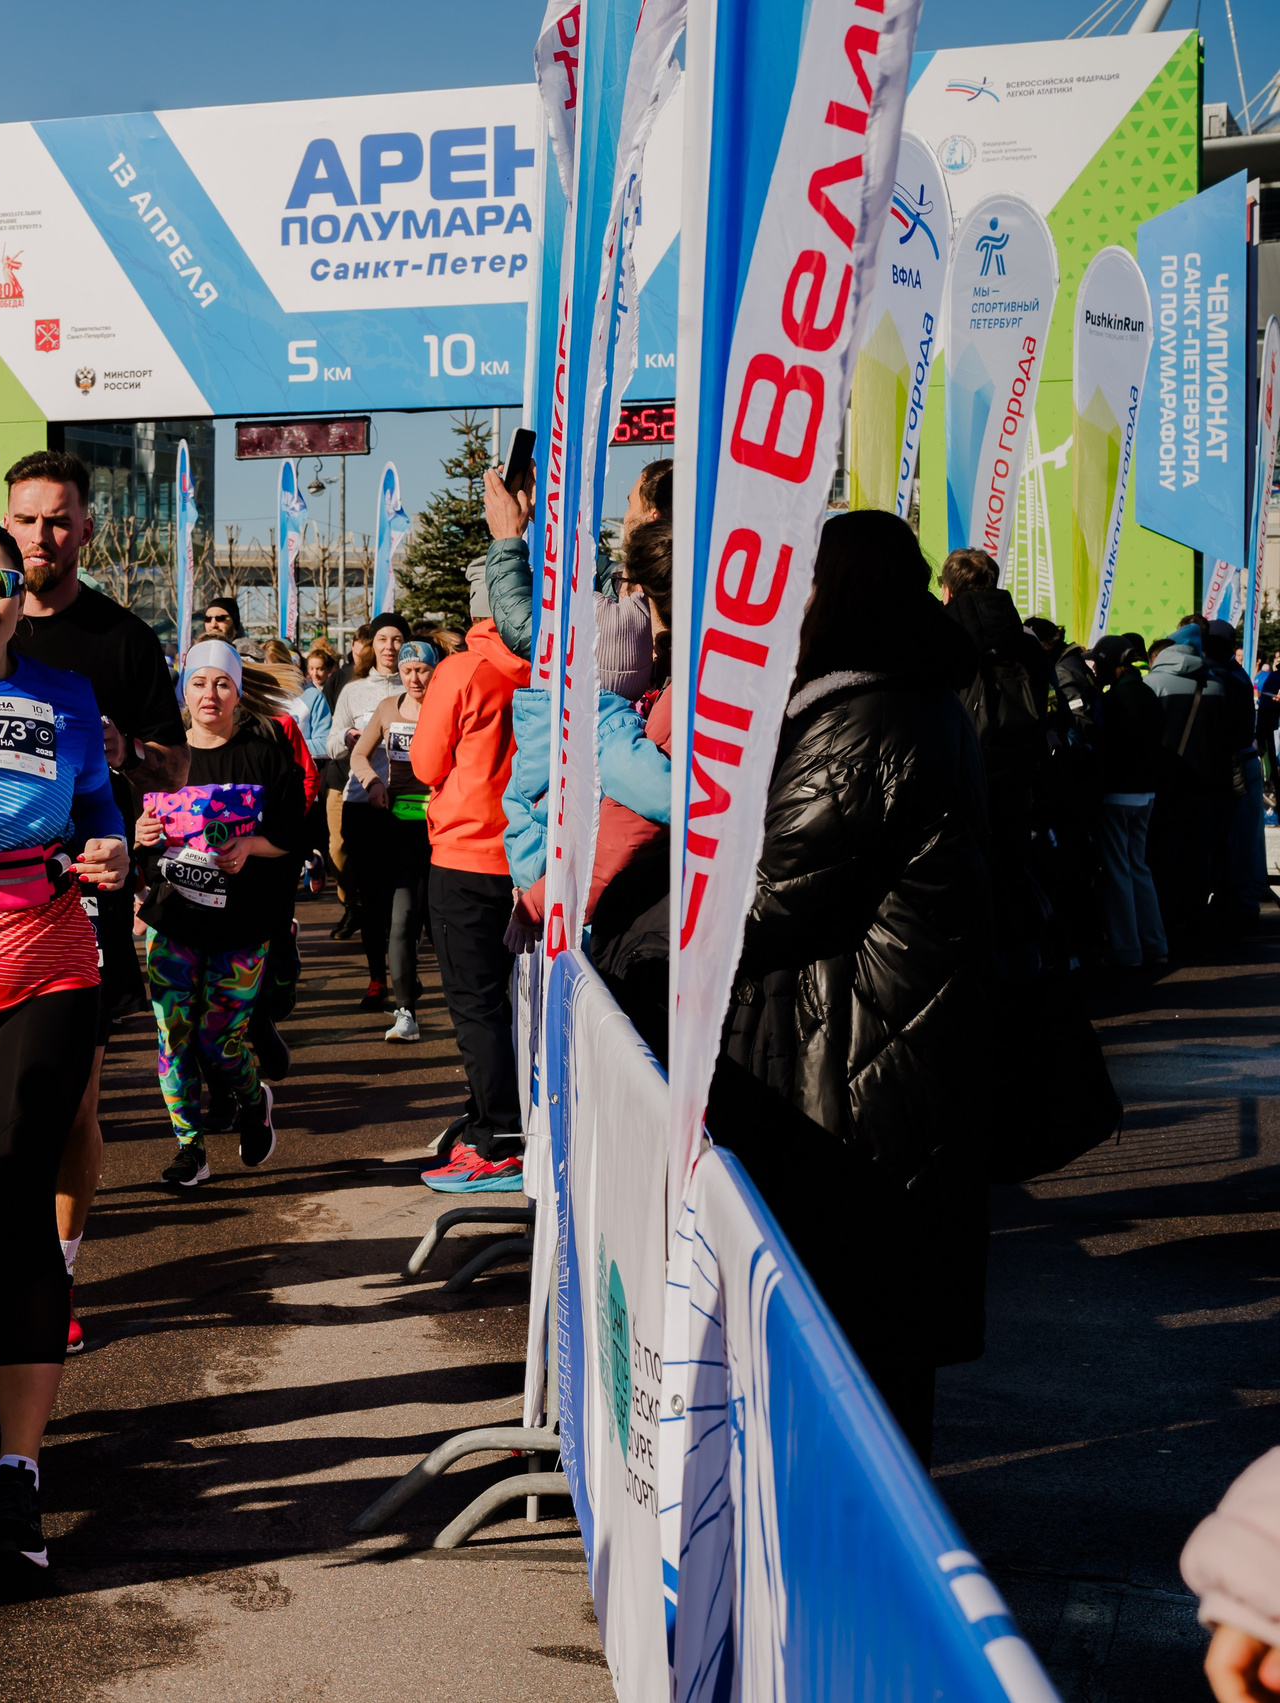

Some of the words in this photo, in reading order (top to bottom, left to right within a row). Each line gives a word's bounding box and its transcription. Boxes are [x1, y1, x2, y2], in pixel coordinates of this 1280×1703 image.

[1006, 77, 1074, 89] ВСЕРОССИЙСКАЯ
[1076, 73, 1120, 83] ФЕДЕРАЦИЯ
[1006, 89, 1035, 98] ЛЕГКОЙ
[1036, 86, 1073, 96] АТЛЕТИКИ
[108, 152, 137, 188] 13
[128, 191, 219, 309] АПРЕЛЯ
[730, 0, 885, 484] Вели
[310, 252, 528, 281] Санкт-Петер
[892, 264, 922, 289] ВФЛА
[1161, 255, 1178, 289] ПО
[973, 287, 990, 297] МЫ
[971, 298, 1039, 313] СПОРТИВНЫЙ
[970, 317, 1023, 329] ПЕТЕРБУРГ
[1085, 309, 1144, 332] PushkinRun
[288, 340, 318, 382] 5
[324, 367, 351, 381] КМ
[423, 333, 475, 377] 10
[481, 361, 509, 375] КМ
[645, 353, 675, 368] КМ
[104, 369, 153, 379] МИНСПОРТ
[1182, 252, 1201, 488] САНКТ-ПЕТЕРБУРГА
[1206, 273, 1229, 463] ЧЕМПИОНАТ
[104, 382, 141, 390] РОССИИ
[998, 335, 1037, 453] города
[1159, 293, 1177, 492] ПОЛУМАРАФОНУ
[32, 705, 43, 714] 10
[35, 747, 54, 757] 2025
[184, 852, 208, 863] АРЕНА
[175, 864, 213, 885] 3109
[179, 879, 205, 889] НАТАЛЬЯ
[644, 1347, 663, 1384] ПО
